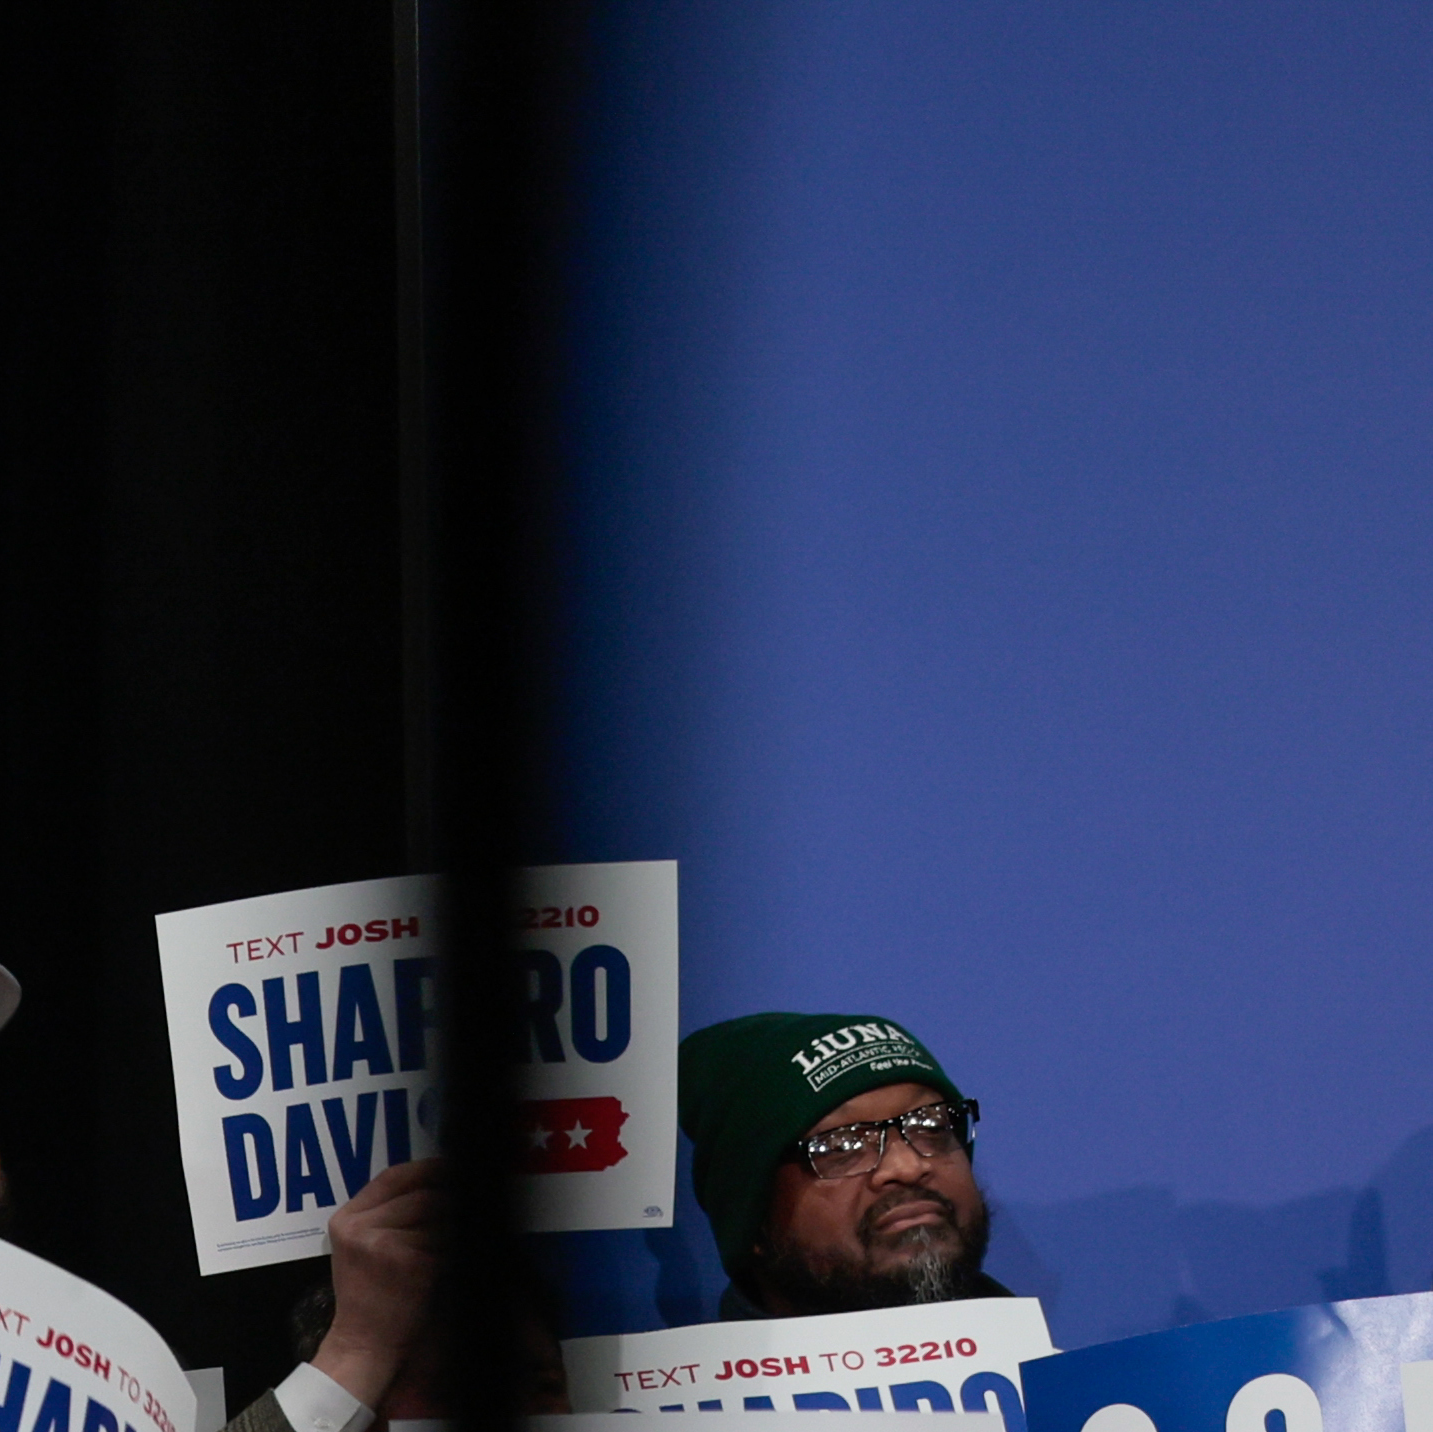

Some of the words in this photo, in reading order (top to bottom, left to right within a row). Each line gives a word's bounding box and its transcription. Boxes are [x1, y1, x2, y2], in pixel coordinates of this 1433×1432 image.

[226, 931, 304, 964] TEXT
[315, 916, 420, 950] JOSH
[521, 905, 600, 929] 2210
[208, 944, 631, 1101] SHAPRO
[221, 1088, 445, 1223] DAVI
[36, 1327, 112, 1382] JOSH
[117, 1366, 141, 1403] TO
[614, 1364, 701, 1393] TEXT
[714, 1355, 811, 1382] JOSH
[818, 1350, 864, 1374] TO
[874, 1337, 978, 1367] 32210
